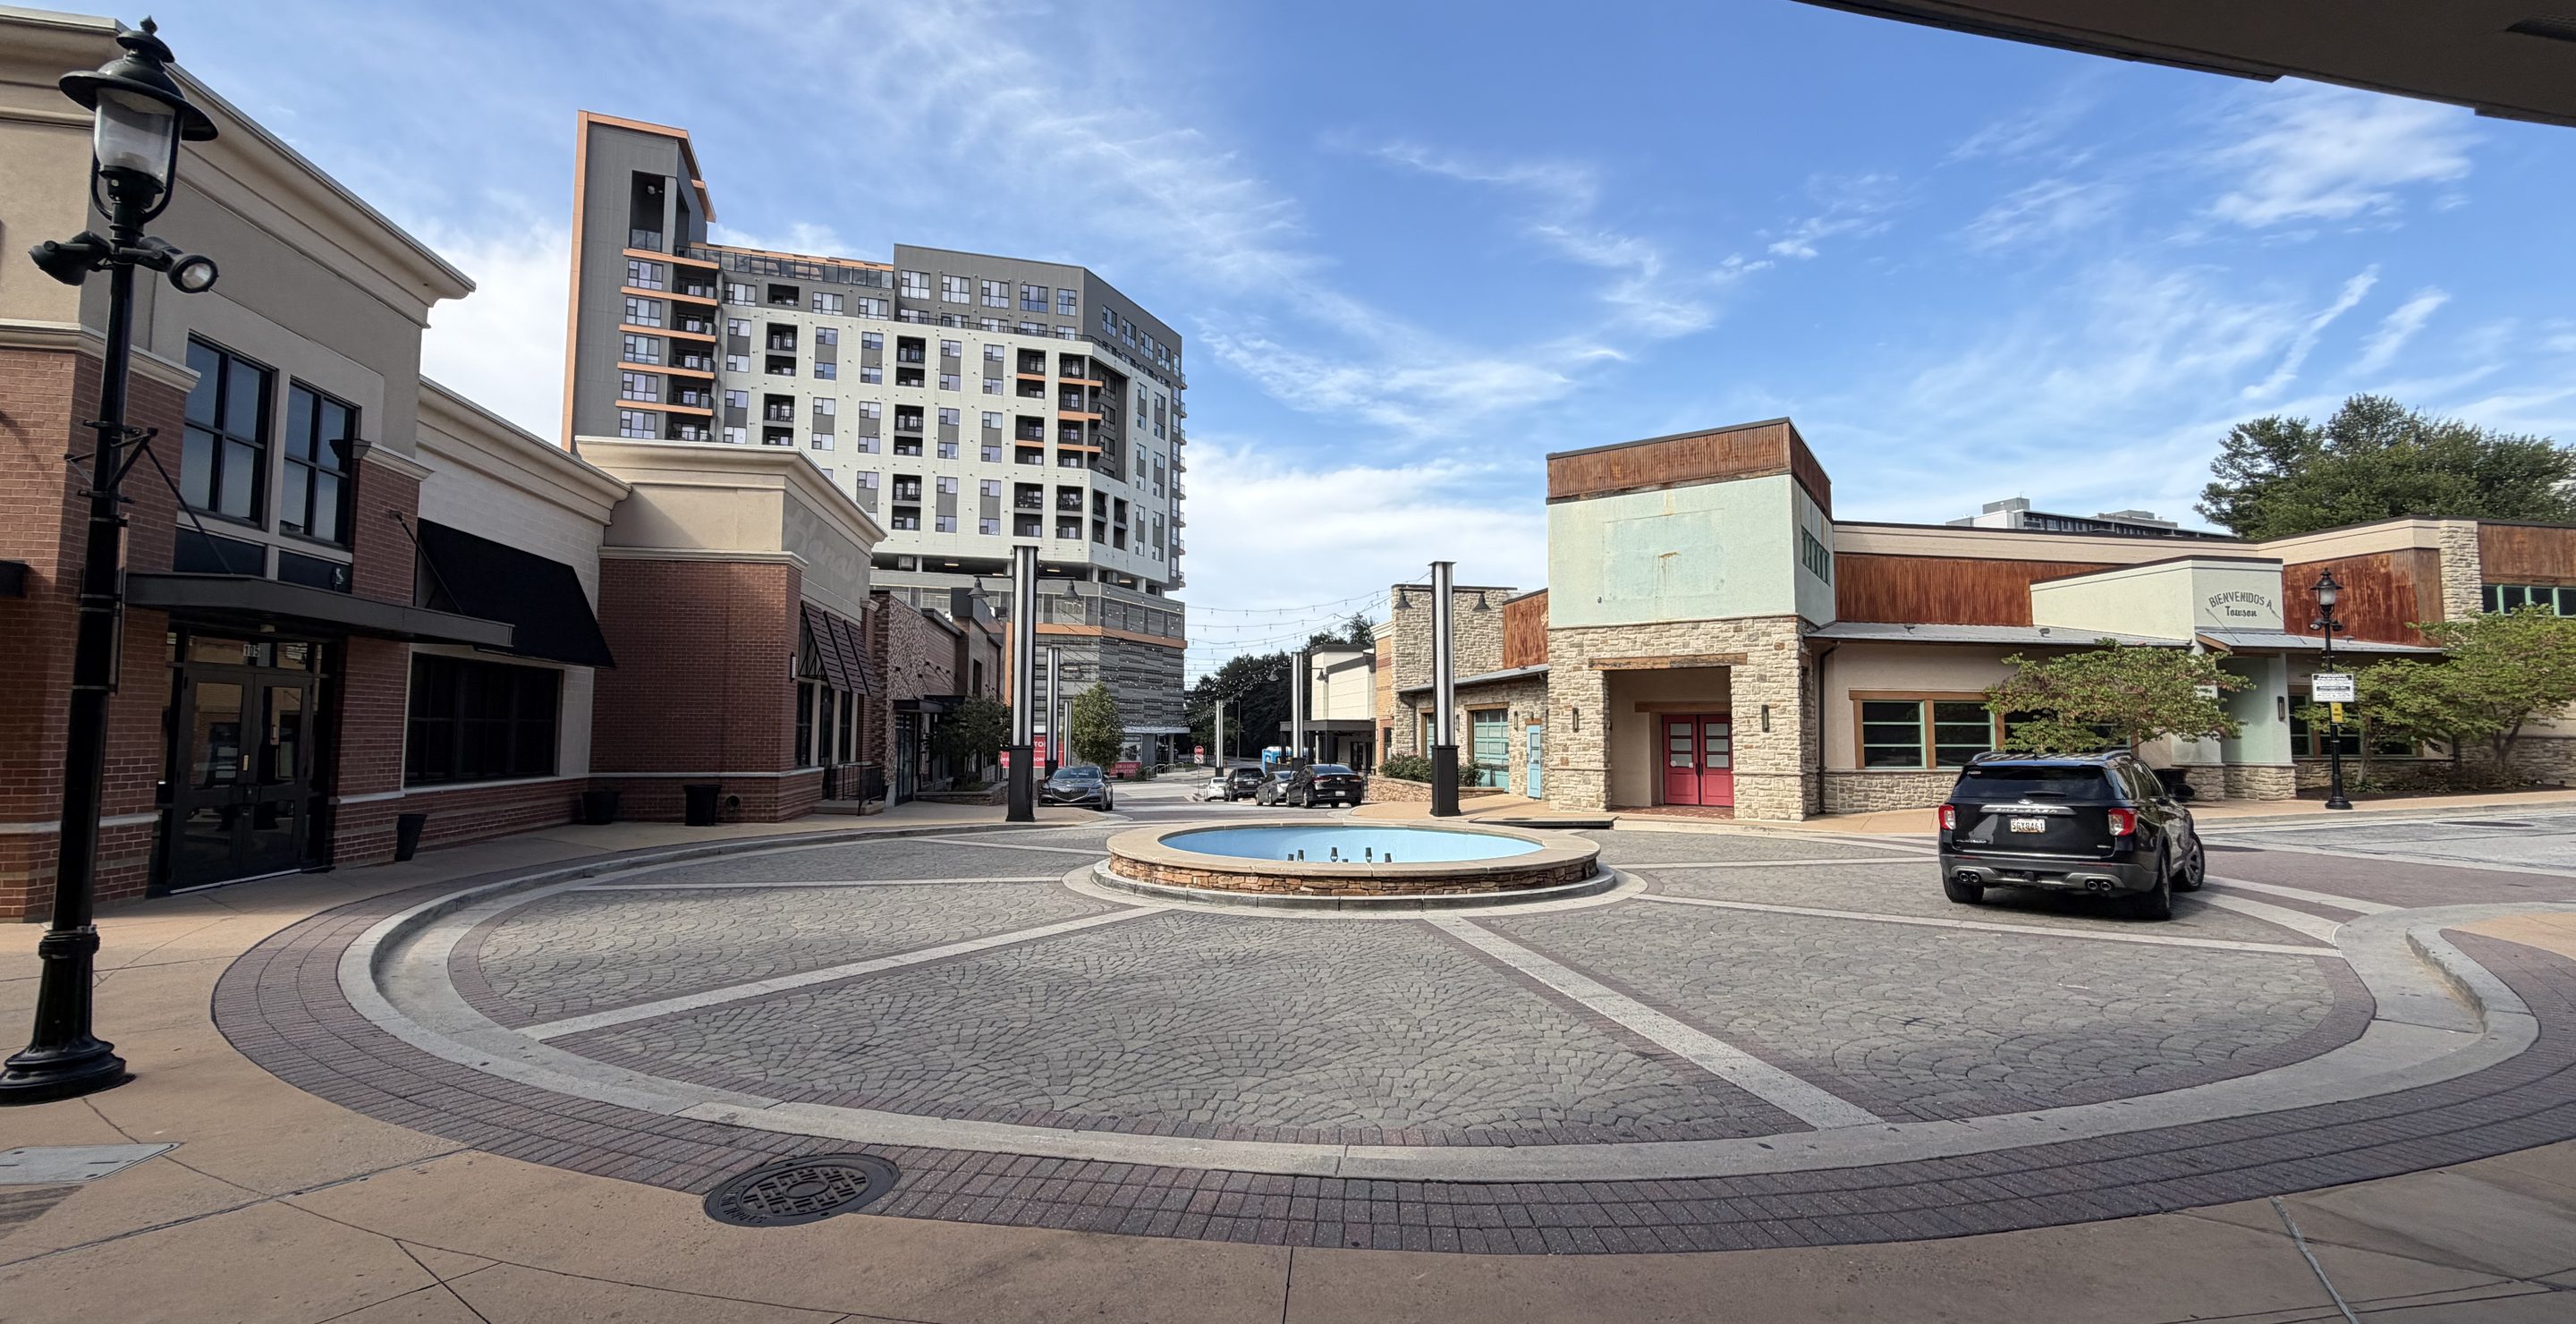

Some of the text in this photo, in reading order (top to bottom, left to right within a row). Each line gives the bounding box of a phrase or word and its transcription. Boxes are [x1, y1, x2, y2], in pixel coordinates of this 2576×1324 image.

[2208, 591, 2273, 610] BIENVENIDOS A
[2224, 606, 2258, 616] Towson
[245, 645, 259, 656] 105
